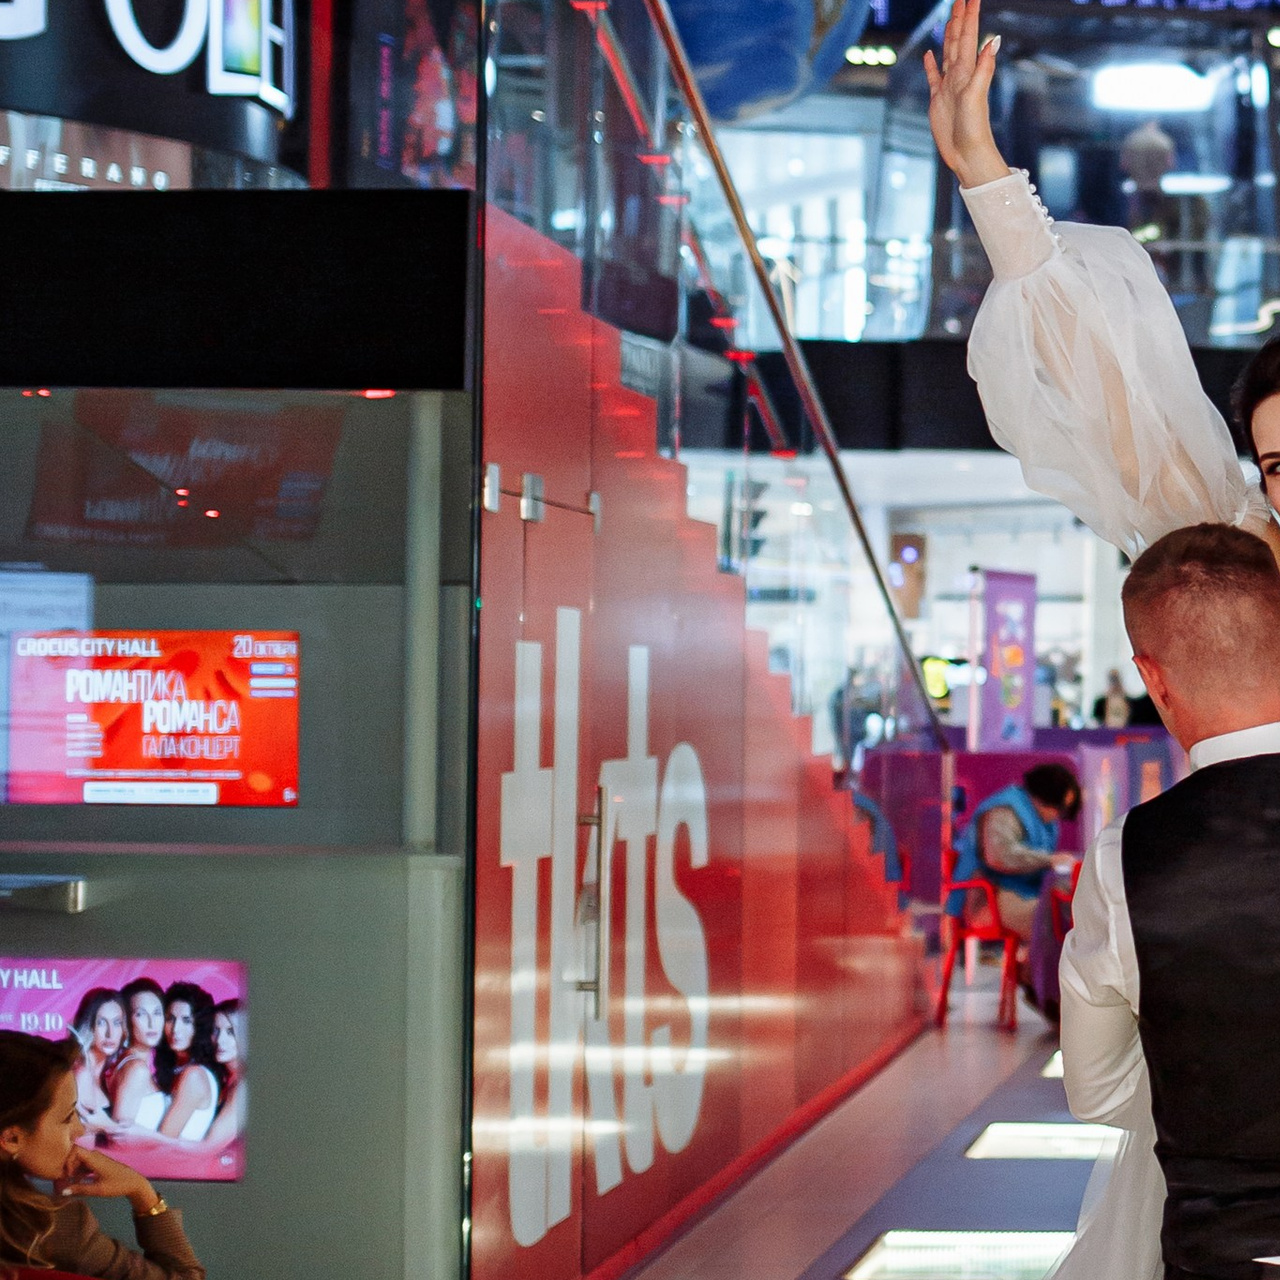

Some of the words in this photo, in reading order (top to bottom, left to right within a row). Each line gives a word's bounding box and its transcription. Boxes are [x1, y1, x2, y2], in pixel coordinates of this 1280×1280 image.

[0, 145, 170, 191] FFERANO
[16, 637, 80, 657] CROCUS
[80, 638, 118, 657] CITY
[117, 638, 161, 658] HALL
[232, 634, 252, 658] 20
[64, 668, 188, 704] РОМАНТИКА
[142, 699, 241, 735] РОМАНСА
[13, 968, 64, 990] HALL
[19, 1011, 64, 1033] 19.10
